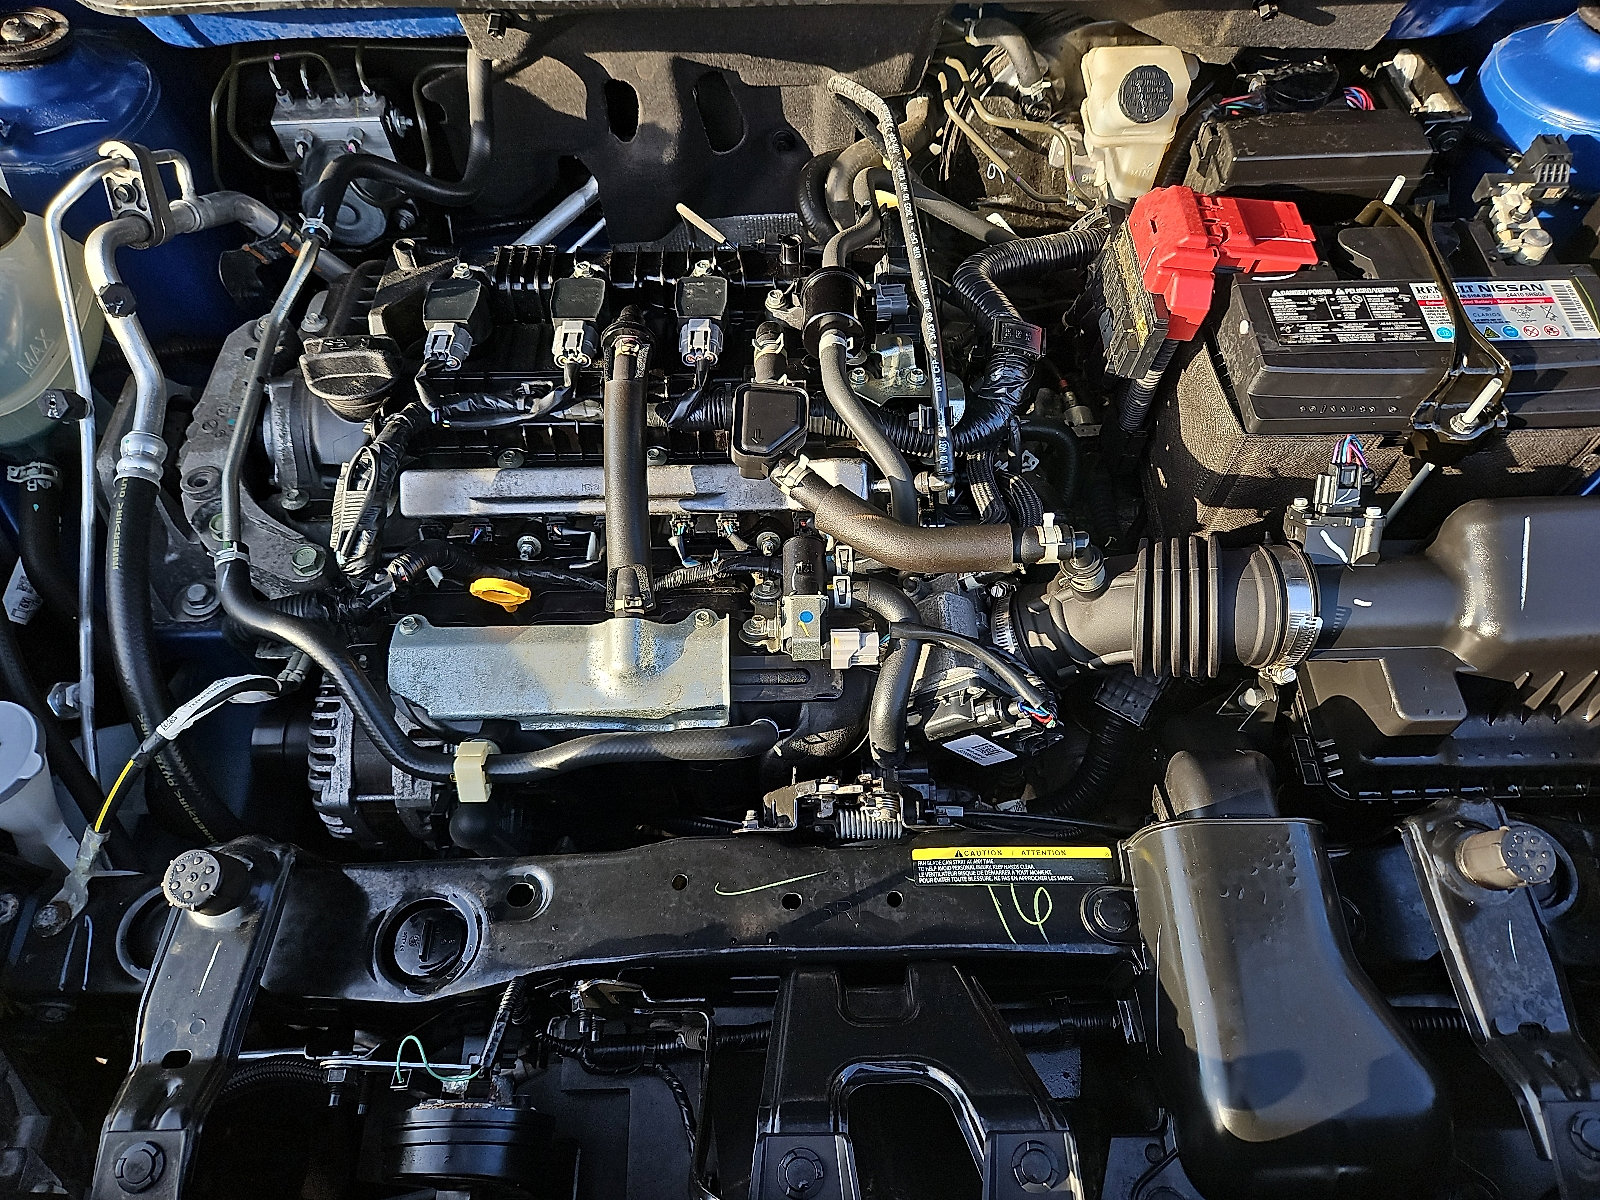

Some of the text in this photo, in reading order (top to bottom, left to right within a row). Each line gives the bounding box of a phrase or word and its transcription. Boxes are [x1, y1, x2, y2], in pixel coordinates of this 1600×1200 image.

[1478, 284, 1544, 292] NISSAN
[16, 328, 53, 376] MAX
[932, 359, 940, 374] CFP
[934, 377, 942, 392] DTR
[963, 849, 1003, 857] CAUTION
